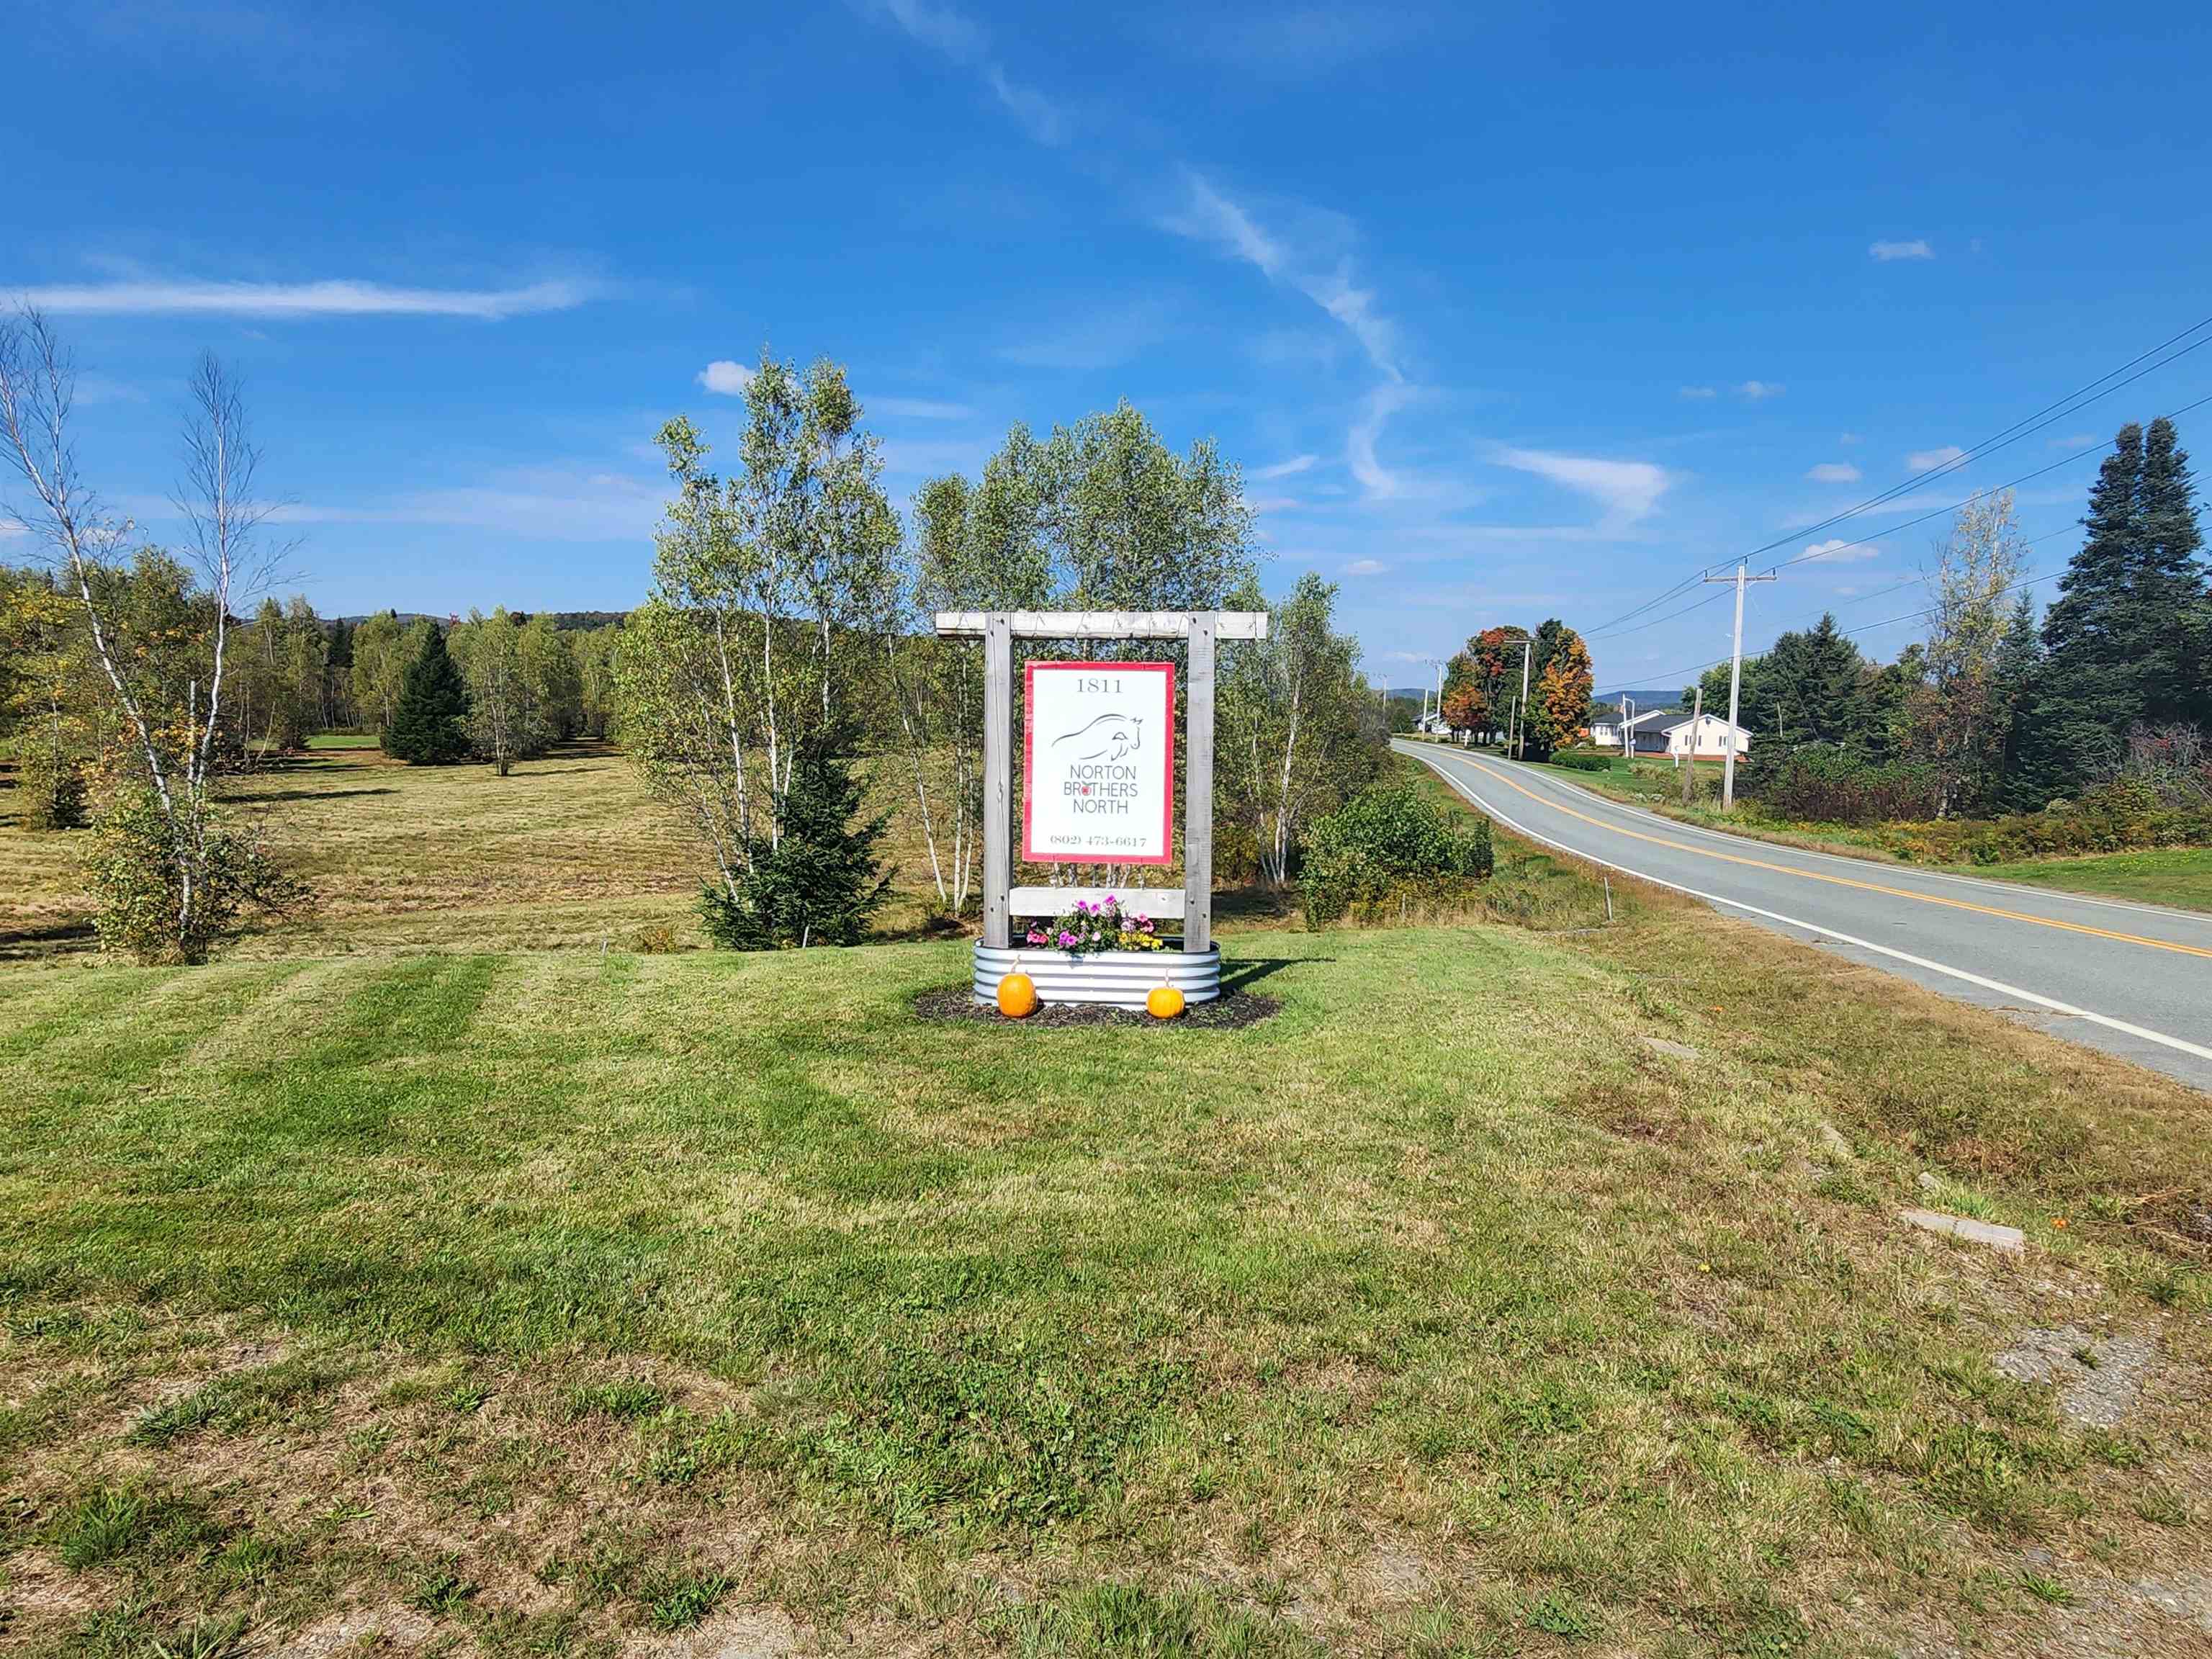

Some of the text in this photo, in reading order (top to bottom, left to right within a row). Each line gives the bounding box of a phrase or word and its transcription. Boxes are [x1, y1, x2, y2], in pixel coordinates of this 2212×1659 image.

[1077, 678, 1123, 693] 1811
[1070, 765, 1136, 780] NORTON
[1064, 781, 1138, 797] BROTHERS
[1073, 799, 1128, 814] NORTH
